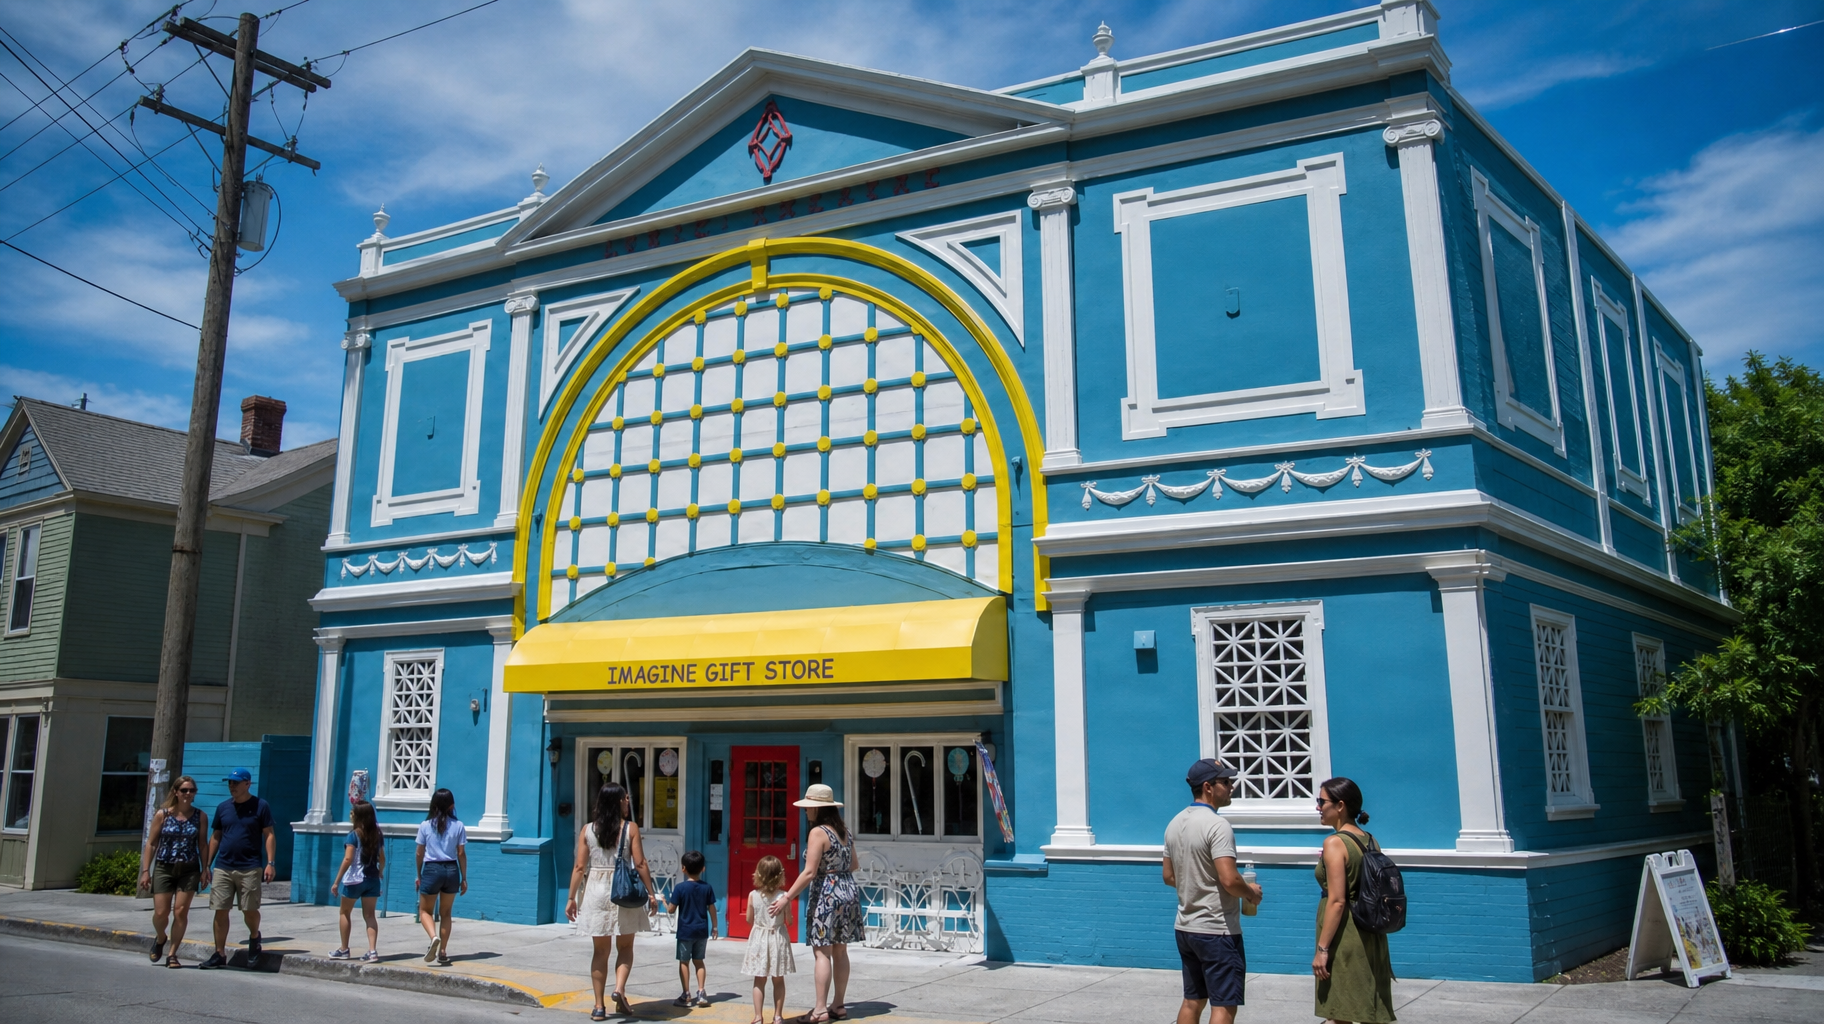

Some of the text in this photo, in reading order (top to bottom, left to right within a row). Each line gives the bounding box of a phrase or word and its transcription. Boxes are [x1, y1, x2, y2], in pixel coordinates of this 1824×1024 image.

[607, 658, 834, 685] IMAGINE GIFT STORE
